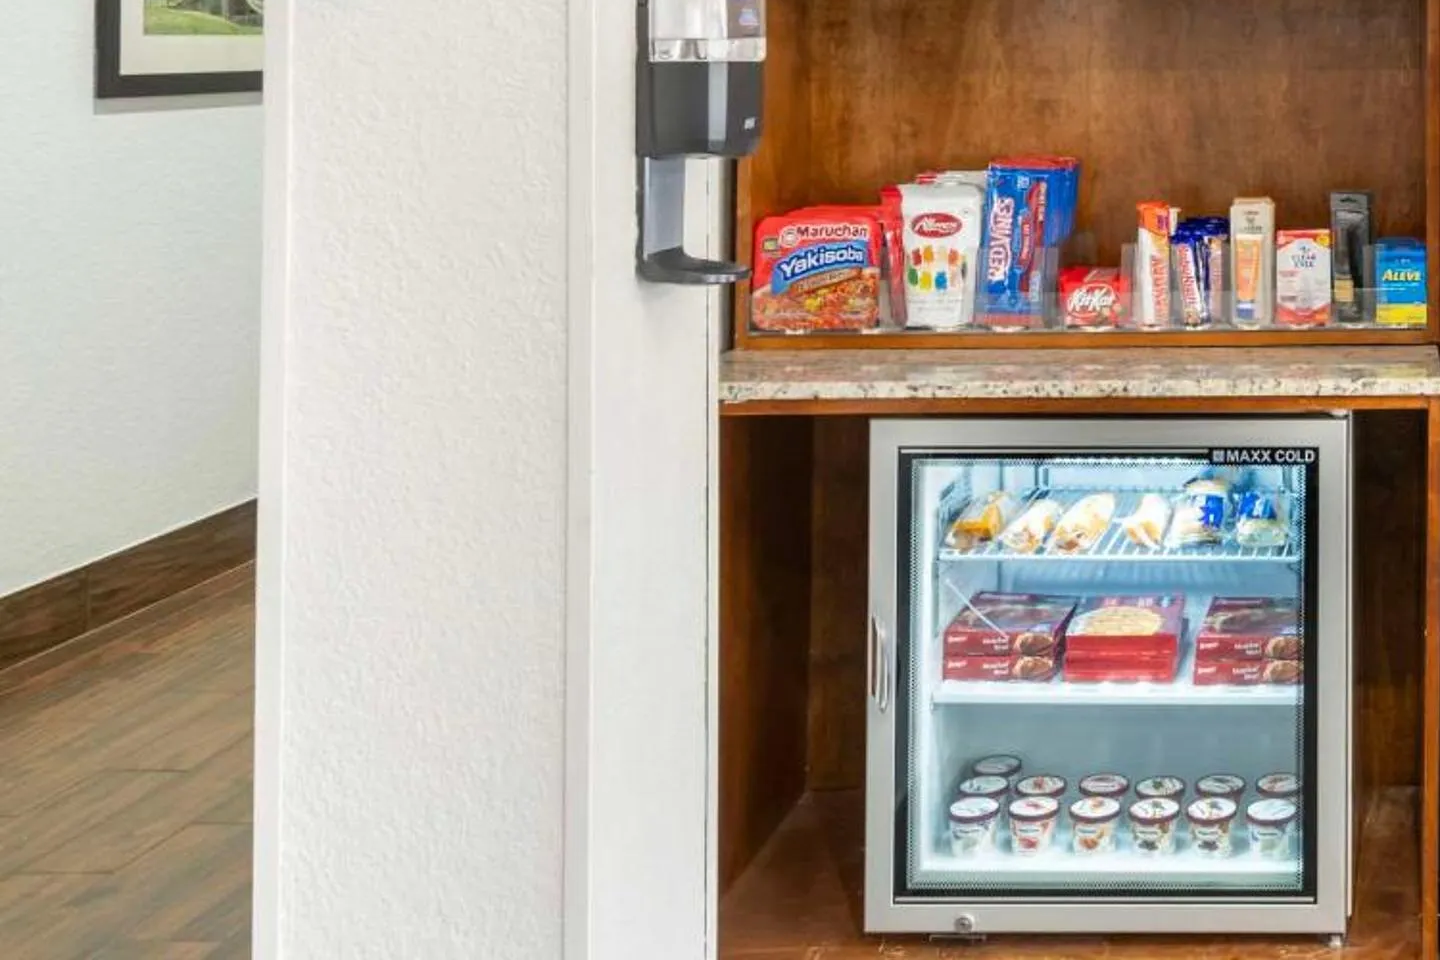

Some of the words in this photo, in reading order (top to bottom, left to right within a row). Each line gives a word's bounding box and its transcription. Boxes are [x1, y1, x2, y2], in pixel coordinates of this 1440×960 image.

[796, 223, 869, 239] Maruchan
[780, 243, 864, 280] Yakisoba
[1226, 449, 1272, 463] MAXX
[1274, 449, 1316, 463] COLD
